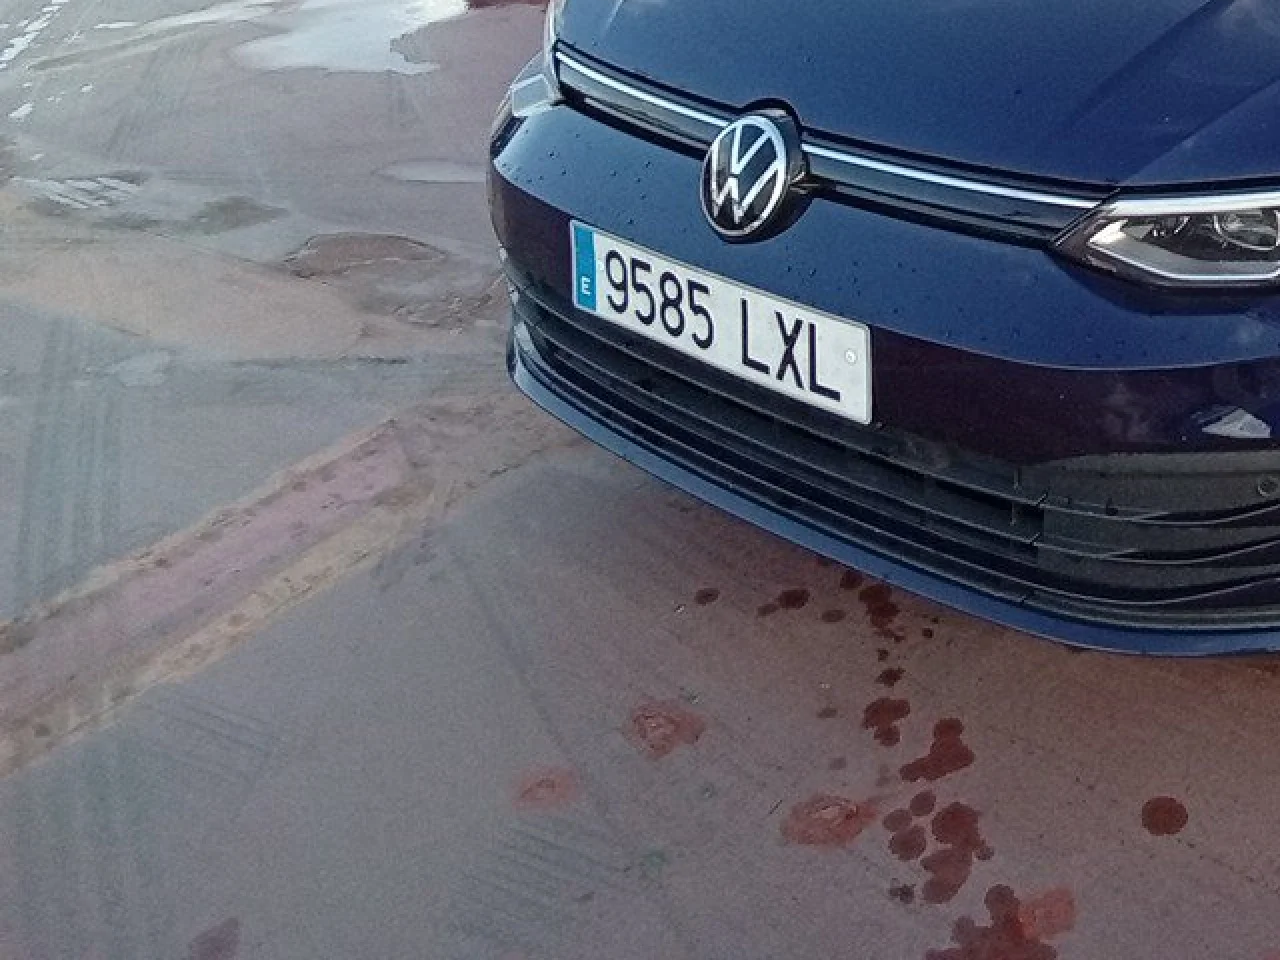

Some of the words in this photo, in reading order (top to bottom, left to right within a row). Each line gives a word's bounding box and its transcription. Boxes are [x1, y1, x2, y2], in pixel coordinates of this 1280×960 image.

[581, 276, 591, 295] E
[605, 249, 714, 350] 9585
[740, 298, 841, 402] LXL
